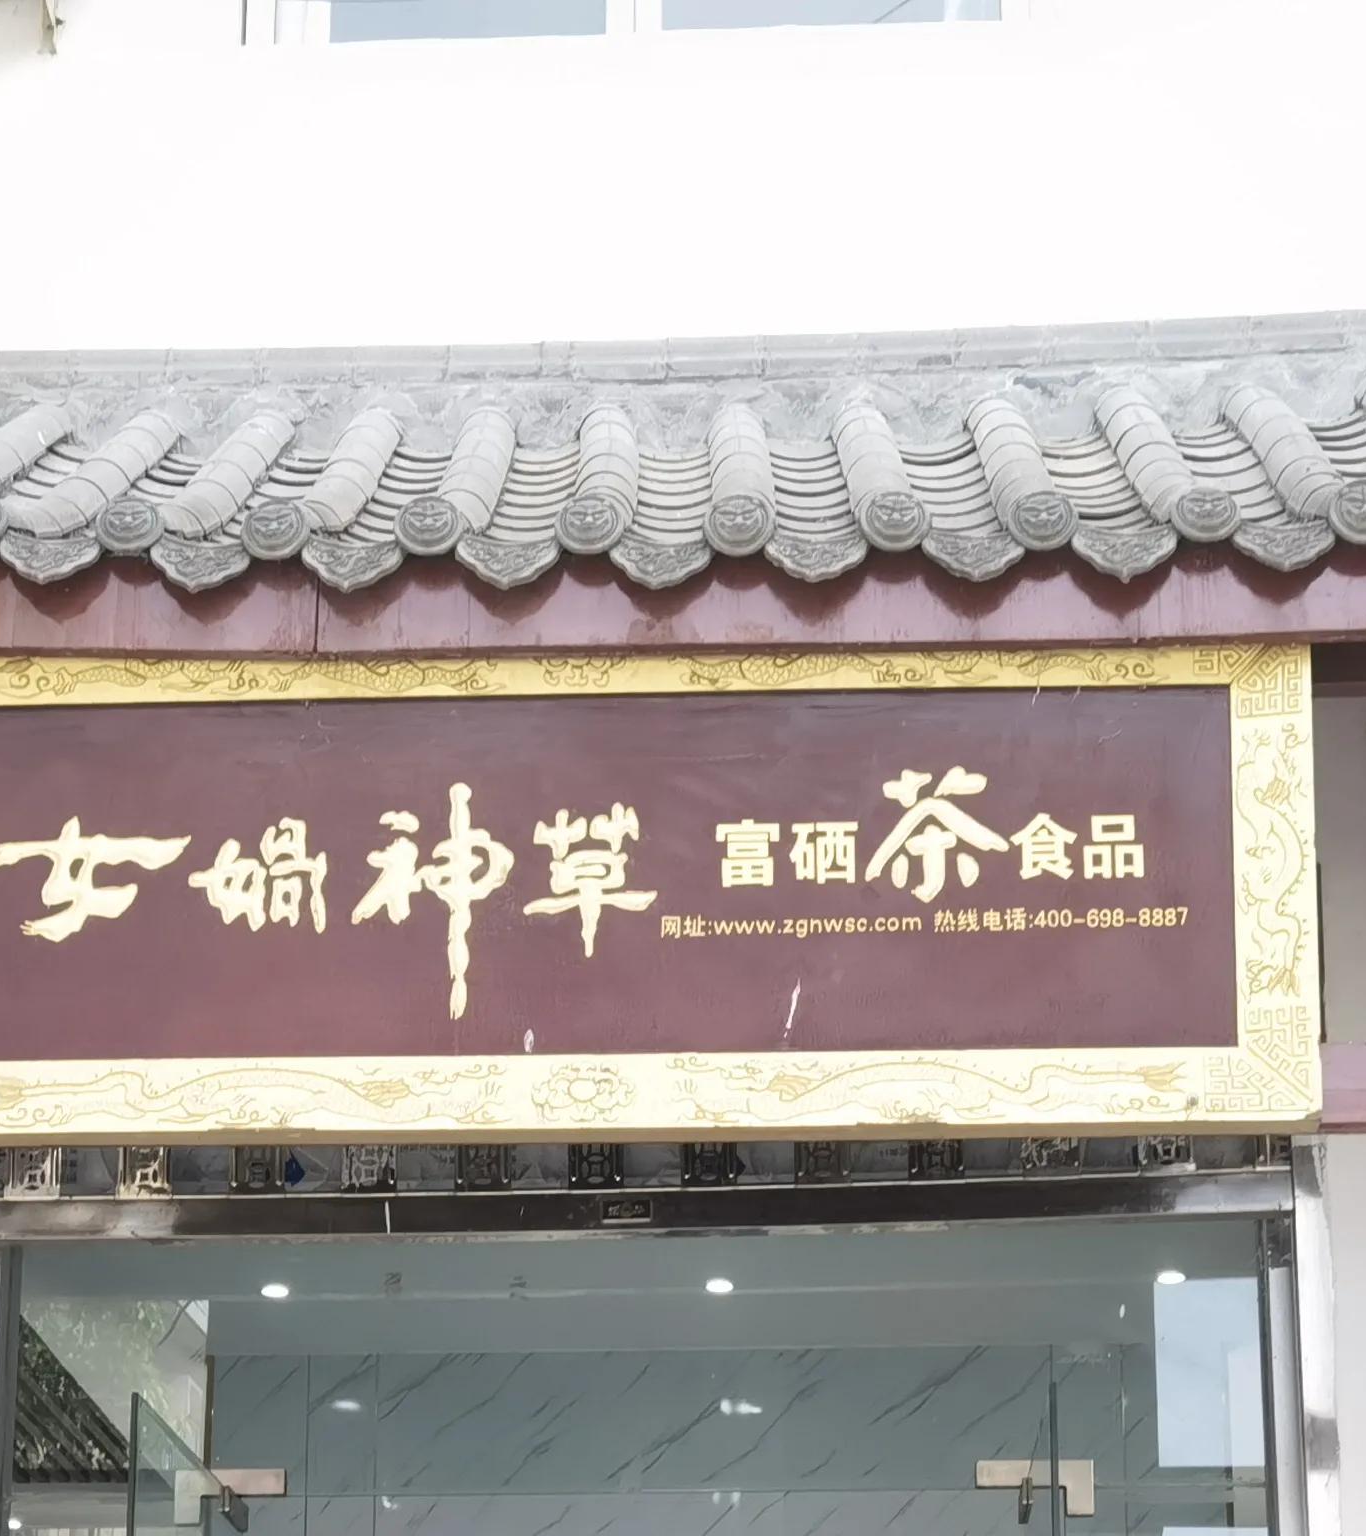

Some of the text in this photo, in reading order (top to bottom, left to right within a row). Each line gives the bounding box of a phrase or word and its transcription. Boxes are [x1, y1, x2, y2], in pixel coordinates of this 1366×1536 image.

[715, 766, 1145, 903] 富硒茶食品
